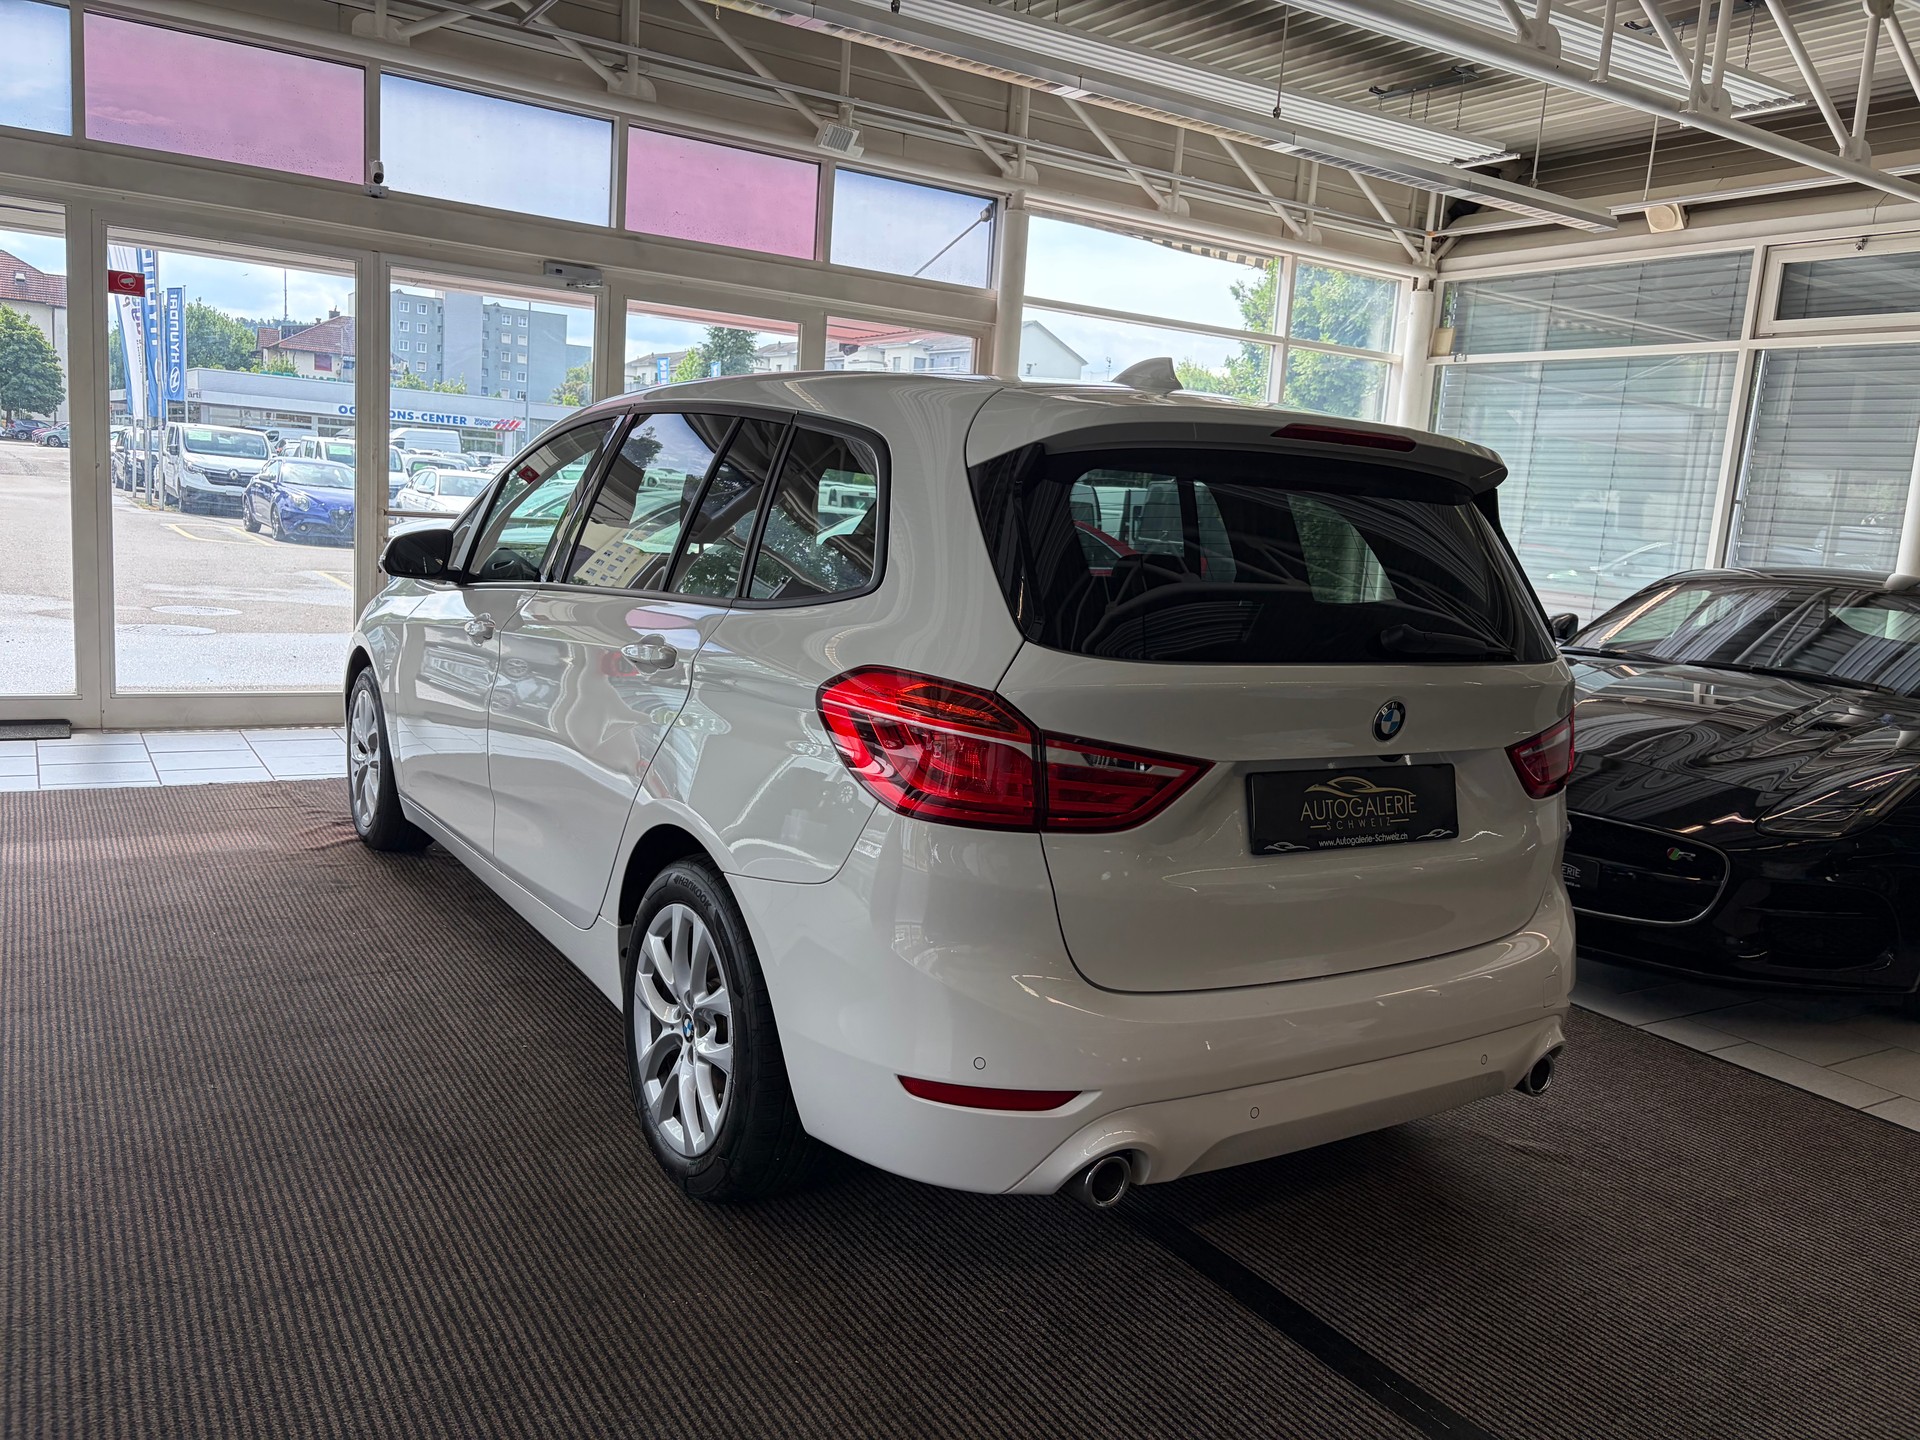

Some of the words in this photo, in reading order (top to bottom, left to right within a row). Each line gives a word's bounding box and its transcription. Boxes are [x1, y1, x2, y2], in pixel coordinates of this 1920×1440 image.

[1300, 794, 1417, 821] AUTOGALERIE
[1326, 817, 1391, 831] SCHWEIZ
[1318, 832, 1408, 847] www.Autogalerie-Schweiz.ch
